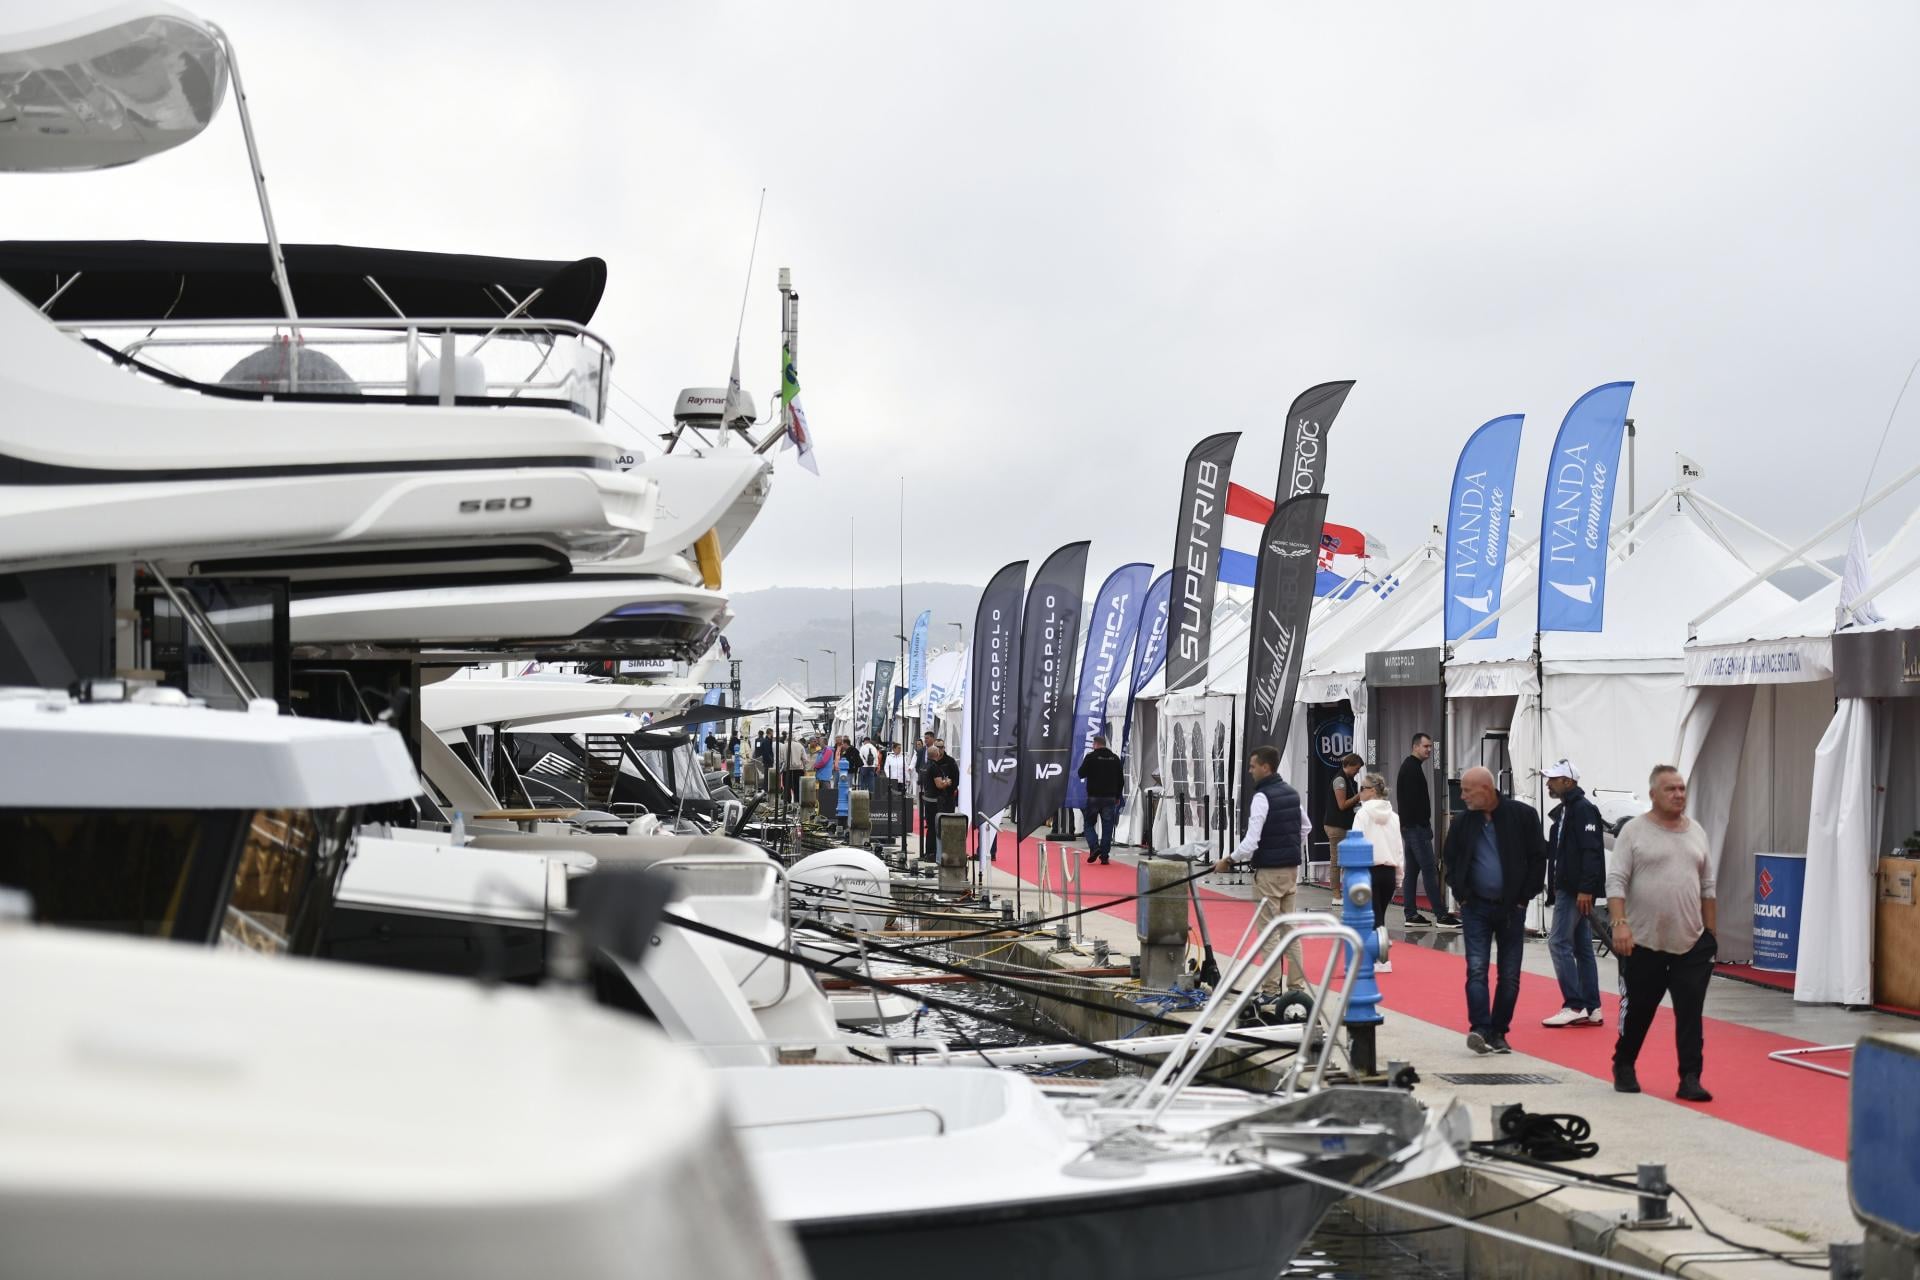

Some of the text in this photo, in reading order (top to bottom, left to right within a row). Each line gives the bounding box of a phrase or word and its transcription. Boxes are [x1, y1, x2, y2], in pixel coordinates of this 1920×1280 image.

[687, 396, 727, 406] Raymar
[459, 497, 532, 513] 560
[1551, 442, 1589, 564] IVANDA
[1585, 462, 1607, 549] commerce
[1683, 467, 1699, 476] Fest
[1181, 460, 1219, 662] SUPERRIB
[1456, 471, 1487, 578] IVANDA
[1485, 486, 1504, 567] commerce
[991, 609, 1000, 736] MARCOPOLO
[1042, 595, 1055, 737] MARCOPOLO
[1090, 594, 1129, 712] NAUTICA
[1254, 610, 1291, 732] Mirakul
[987, 757, 1017, 774] MP
[1035, 763, 1062, 780] MP
